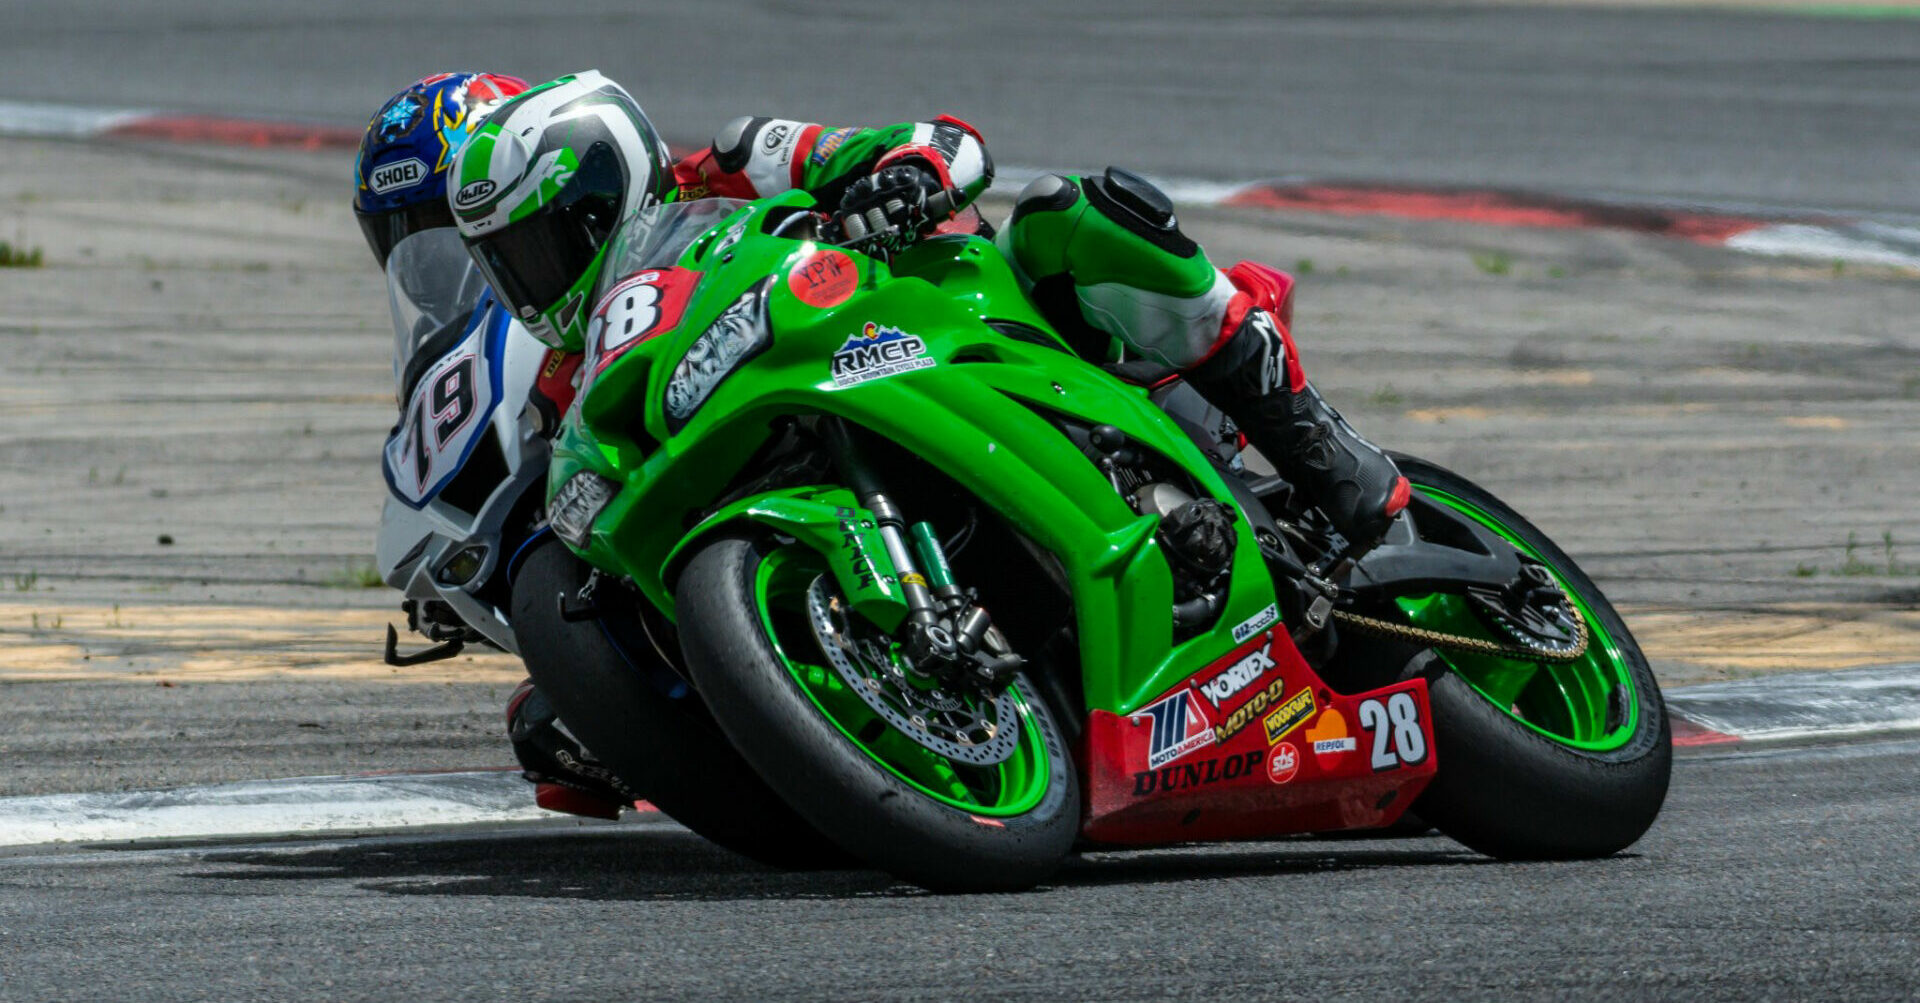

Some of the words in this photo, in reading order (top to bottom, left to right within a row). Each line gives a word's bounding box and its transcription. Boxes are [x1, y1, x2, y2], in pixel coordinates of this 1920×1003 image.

[375, 163, 419, 188] SHOEI
[460, 183, 490, 202] HJC
[833, 339, 921, 375] RMCP
[402, 354, 477, 495] 79
[1200, 643, 1276, 708] VORTEX
[1214, 678, 1284, 743] MOTO-D
[1358, 692, 1426, 771] 28
[1316, 739, 1345, 751] REPSOL
[1133, 750, 1263, 796] DUNLOP
